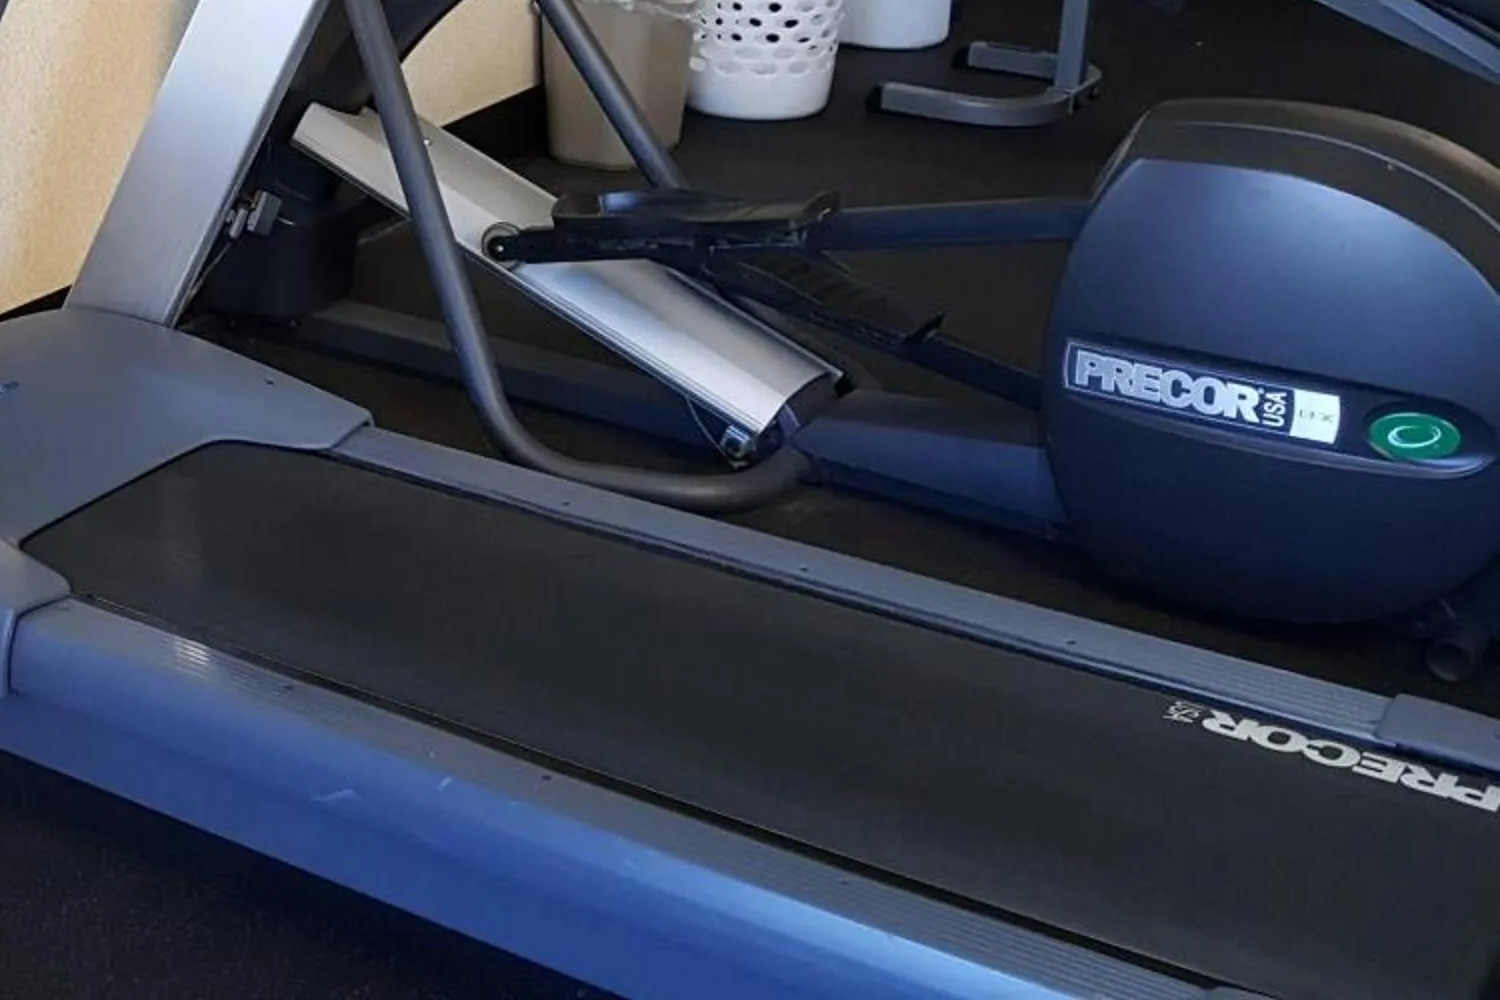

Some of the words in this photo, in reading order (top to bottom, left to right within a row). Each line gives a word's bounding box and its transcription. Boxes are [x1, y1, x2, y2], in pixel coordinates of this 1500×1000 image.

[1074, 350, 1260, 425] PRECOR
[1262, 391, 1288, 427] USA
[1201, 708, 1500, 813] PRECOR
